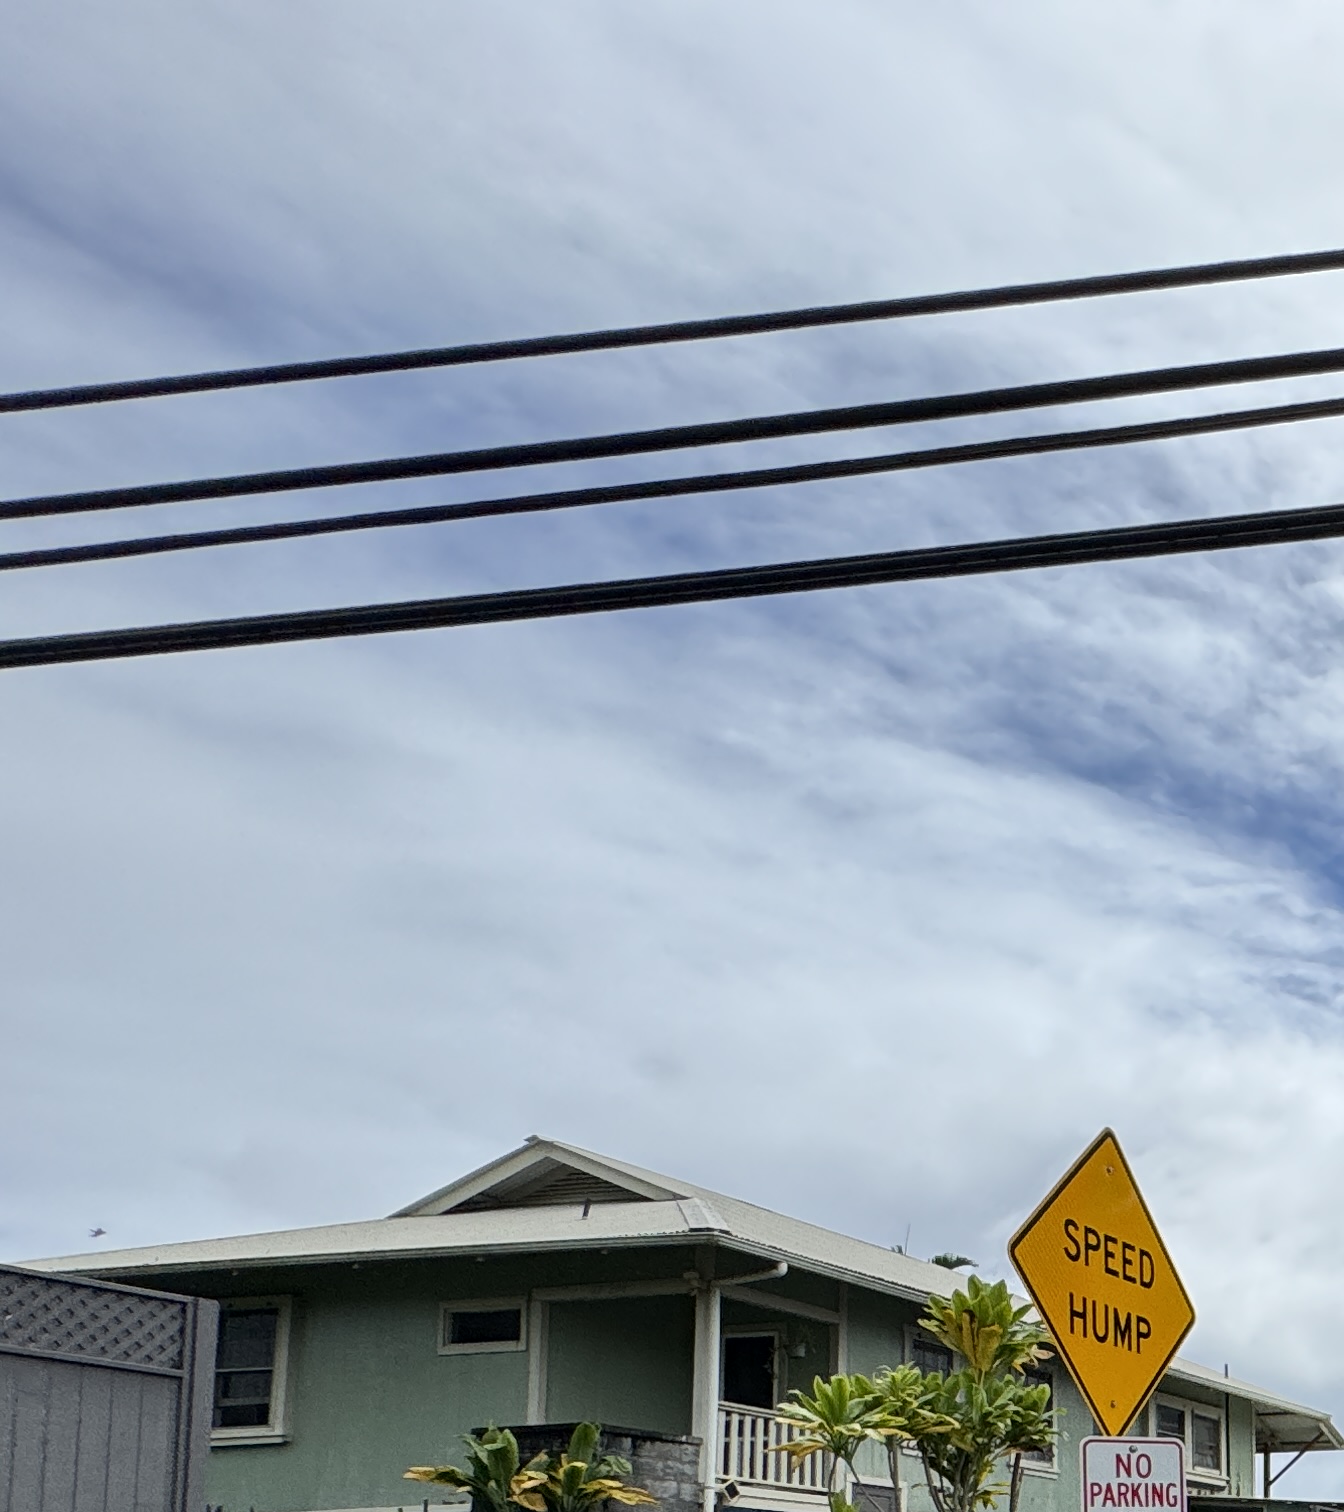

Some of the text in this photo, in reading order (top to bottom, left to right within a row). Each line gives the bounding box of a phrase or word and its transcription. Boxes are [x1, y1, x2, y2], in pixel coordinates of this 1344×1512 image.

[1063, 1218, 1155, 1290] SPEED
[1068, 1292, 1152, 1354] HUMP
[1115, 1453, 1152, 1480] NO
[1089, 1482, 1178, 1509] PARKING
